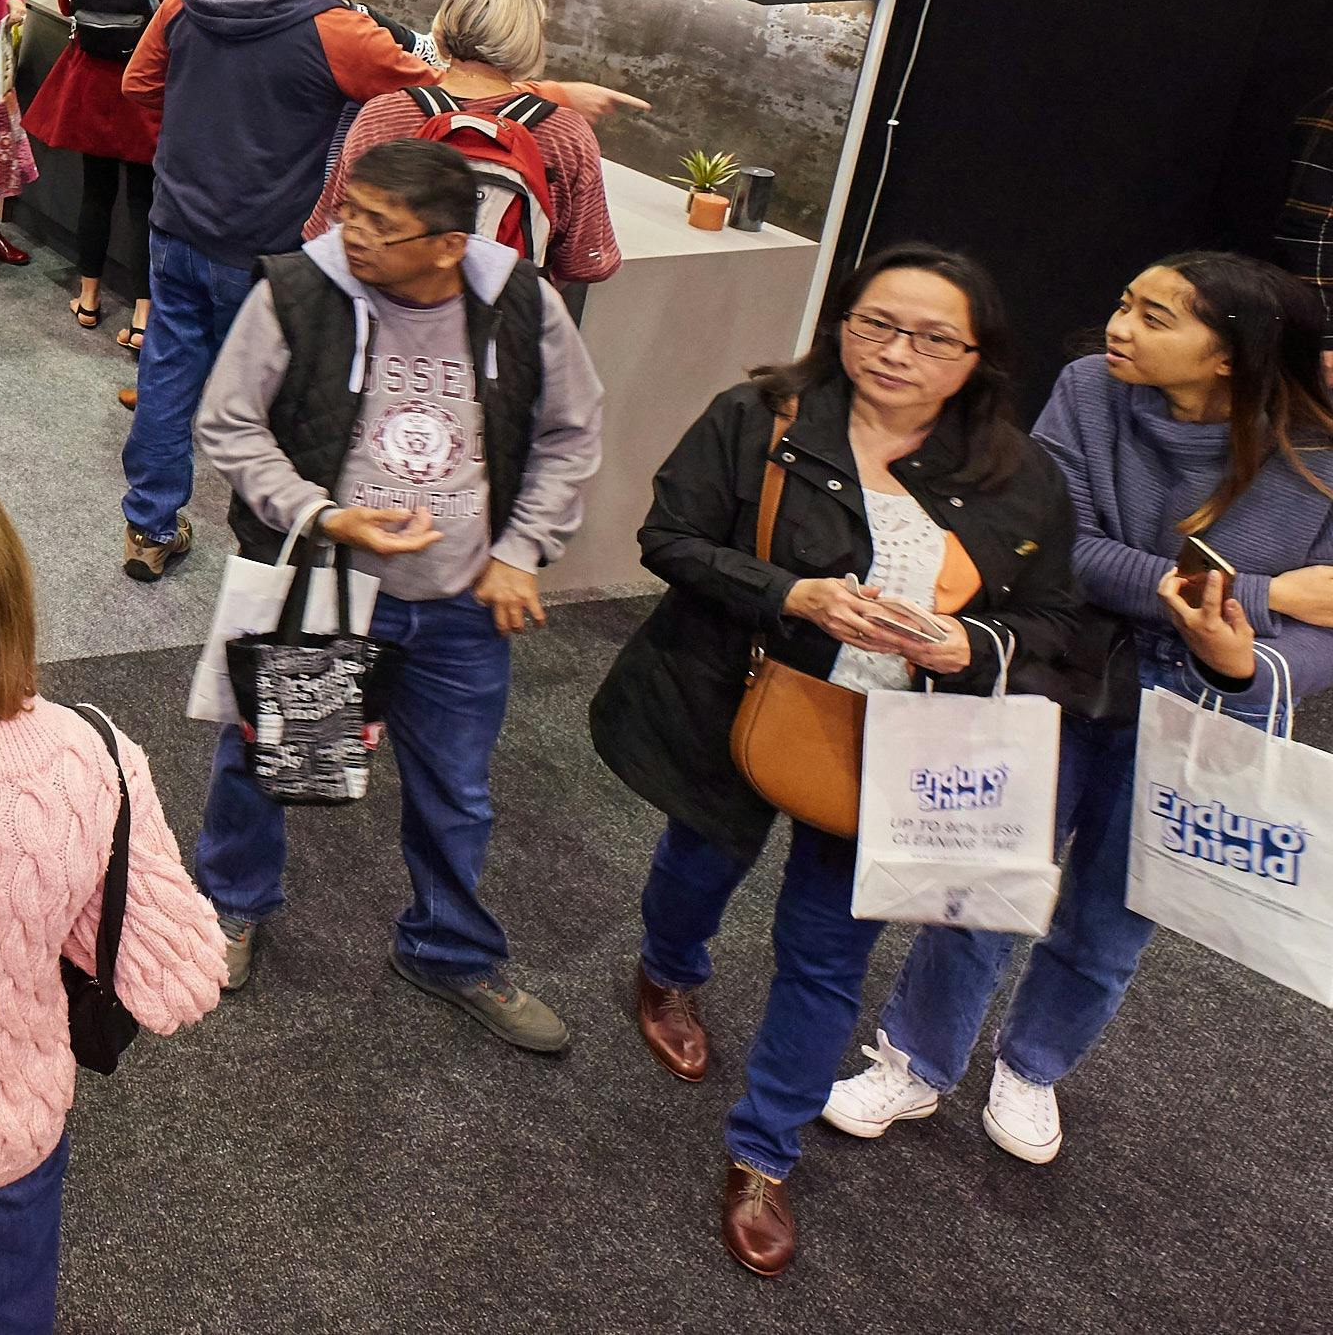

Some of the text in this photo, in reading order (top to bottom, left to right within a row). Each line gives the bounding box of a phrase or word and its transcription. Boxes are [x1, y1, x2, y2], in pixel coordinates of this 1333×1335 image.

[909, 763, 1010, 792] Enduro
[1148, 781, 1307, 854] Enduro
[1161, 818, 1300, 887] Shield
